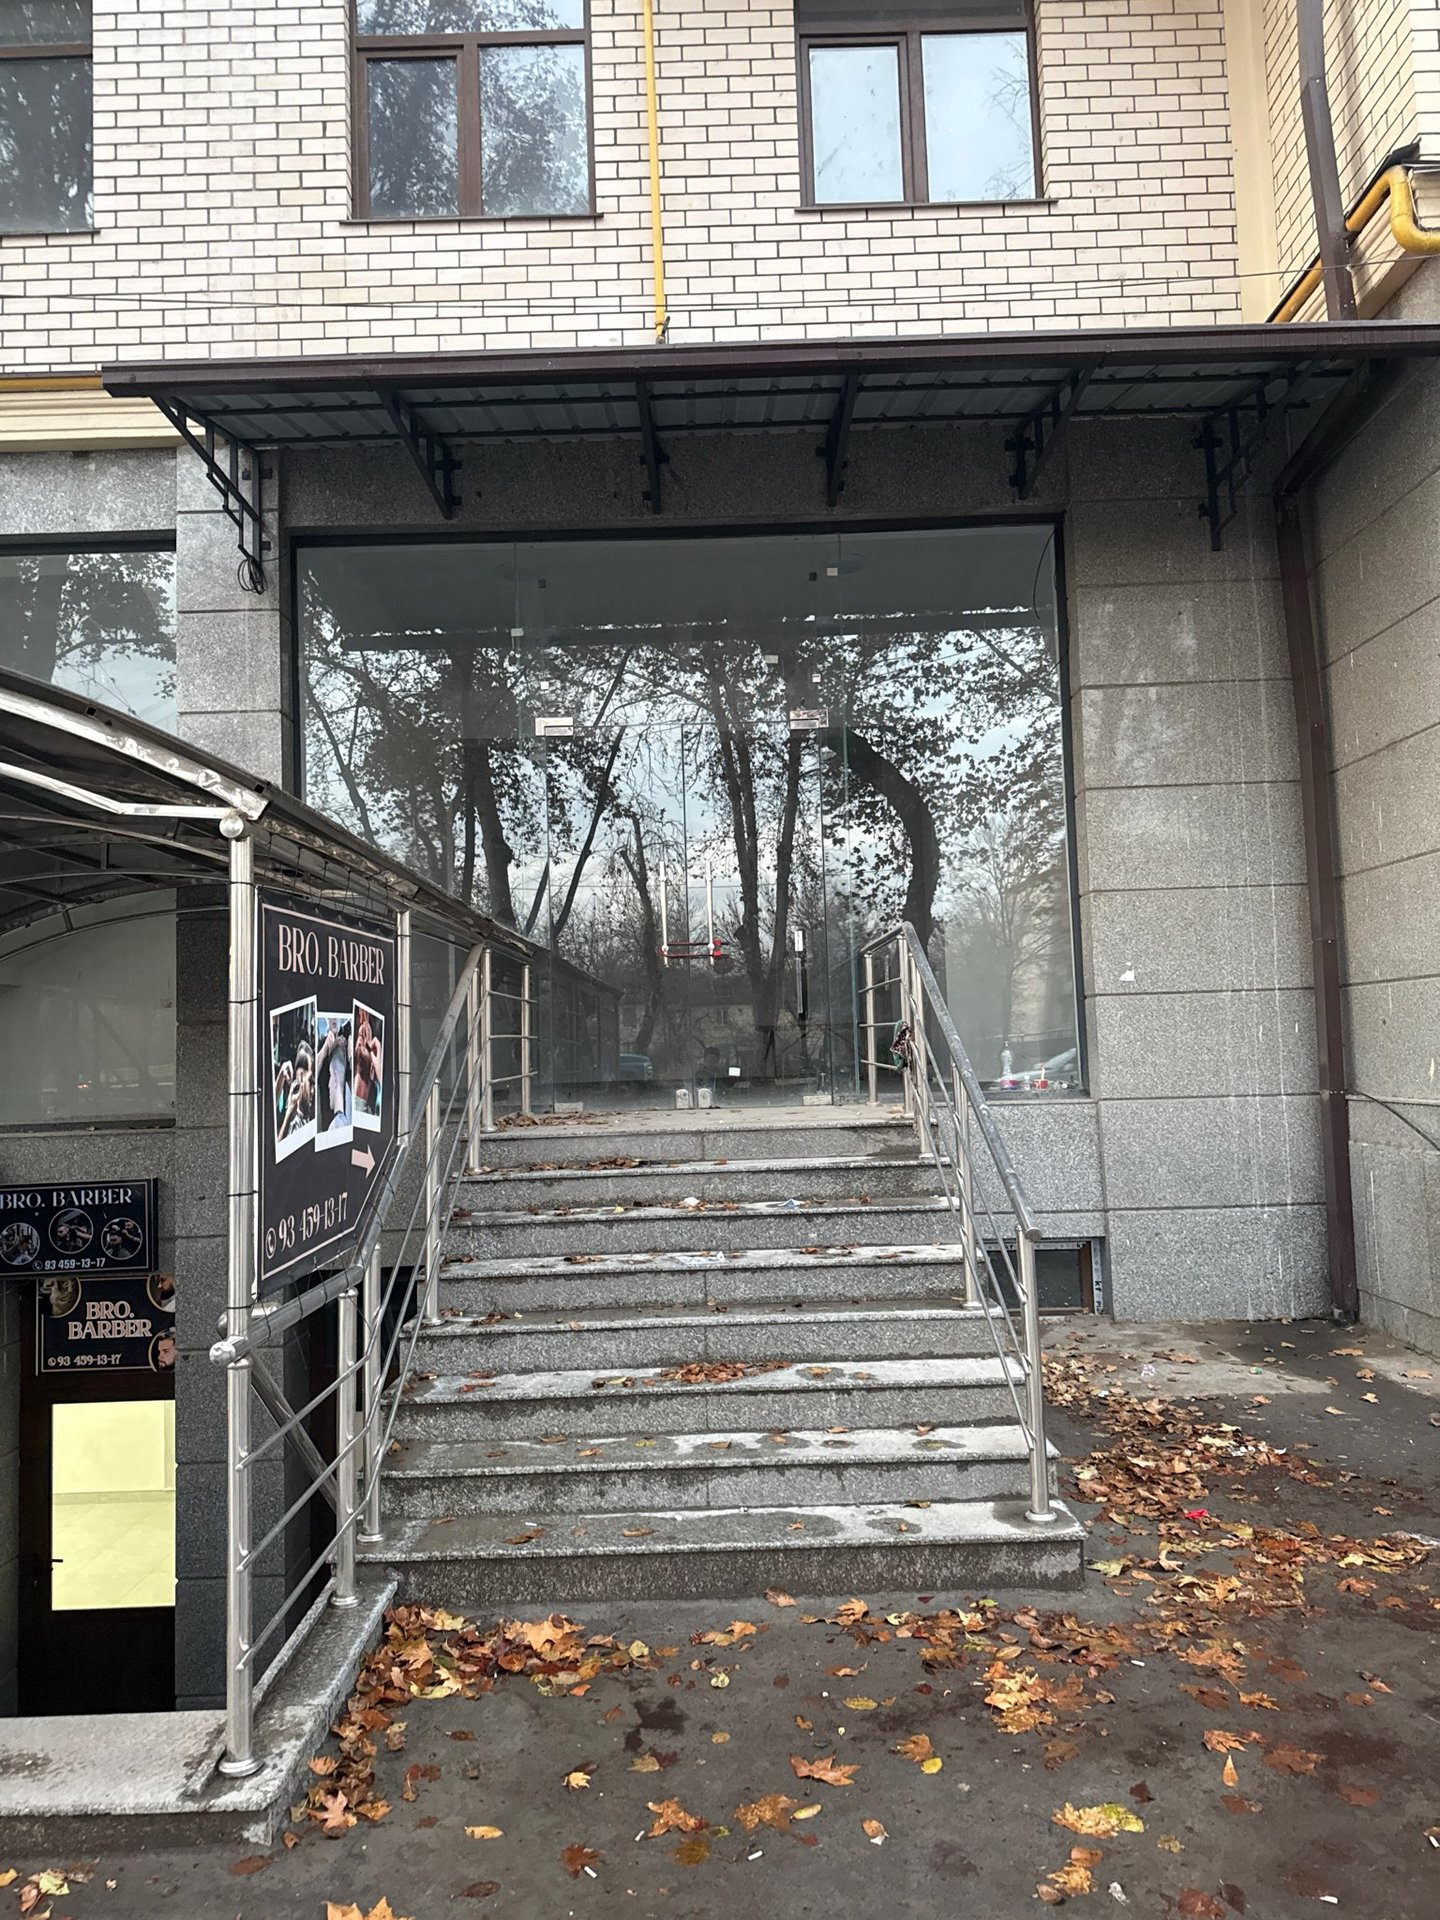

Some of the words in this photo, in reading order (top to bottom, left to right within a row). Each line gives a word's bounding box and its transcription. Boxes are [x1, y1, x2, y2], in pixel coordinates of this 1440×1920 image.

[278, 924, 322, 975] BRO.
[328, 936, 384, 985] BARBER
[0, 1192, 45, 1209] BRO.
[52, 1188, 132, 1207] BARBER
[279, 1215, 295, 1252] 93
[299, 1192, 348, 1241] 459-13-17
[44, 1260, 56, 1270] 93
[58, 1258, 106, 1269] 459-13-17
[86, 1301, 135, 1320] BRO.
[68, 1319, 152, 1340] BARBER
[57, 1356, 71, 1366] 93
[74, 1354, 122, 1366] 459-13-17
